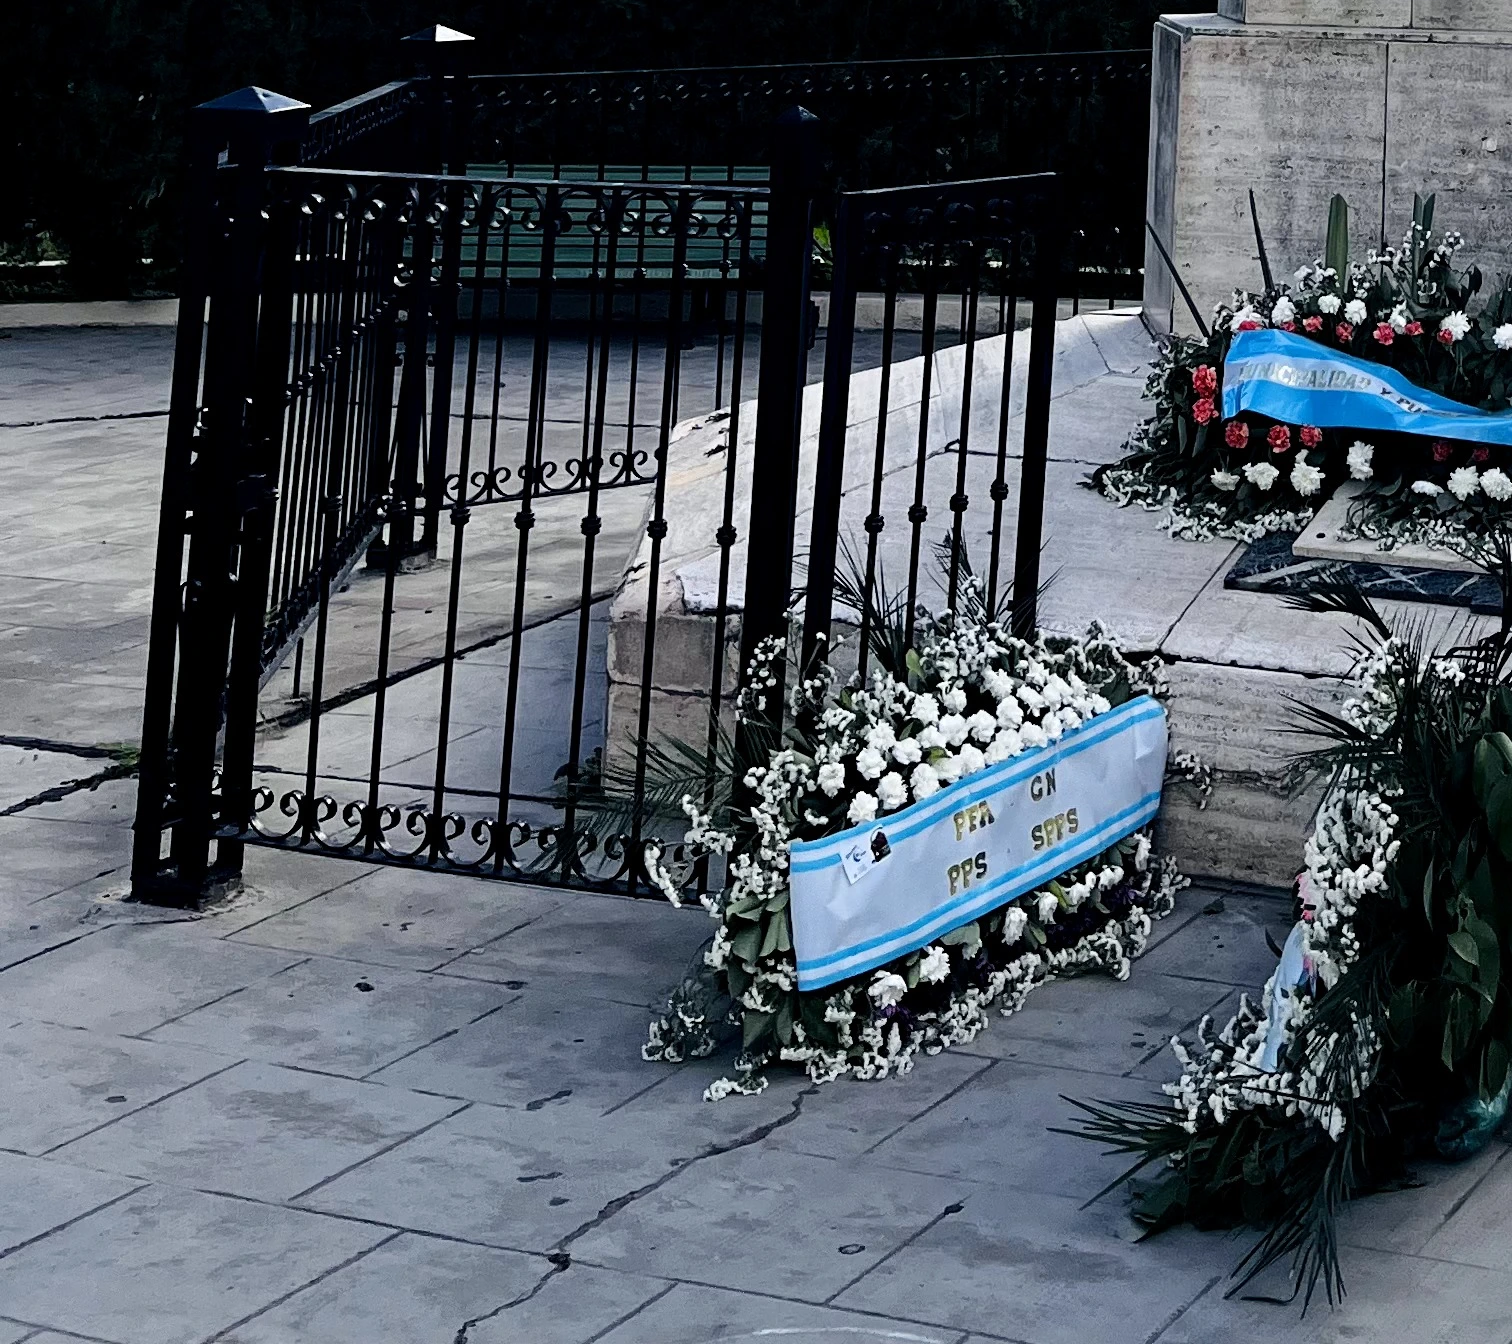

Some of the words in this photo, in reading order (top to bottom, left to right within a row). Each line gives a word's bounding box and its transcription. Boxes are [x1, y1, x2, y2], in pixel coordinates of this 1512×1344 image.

[1030, 767, 1057, 802] GN
[947, 851, 988, 897] PPS
[1030, 807, 1079, 852] SPPS
